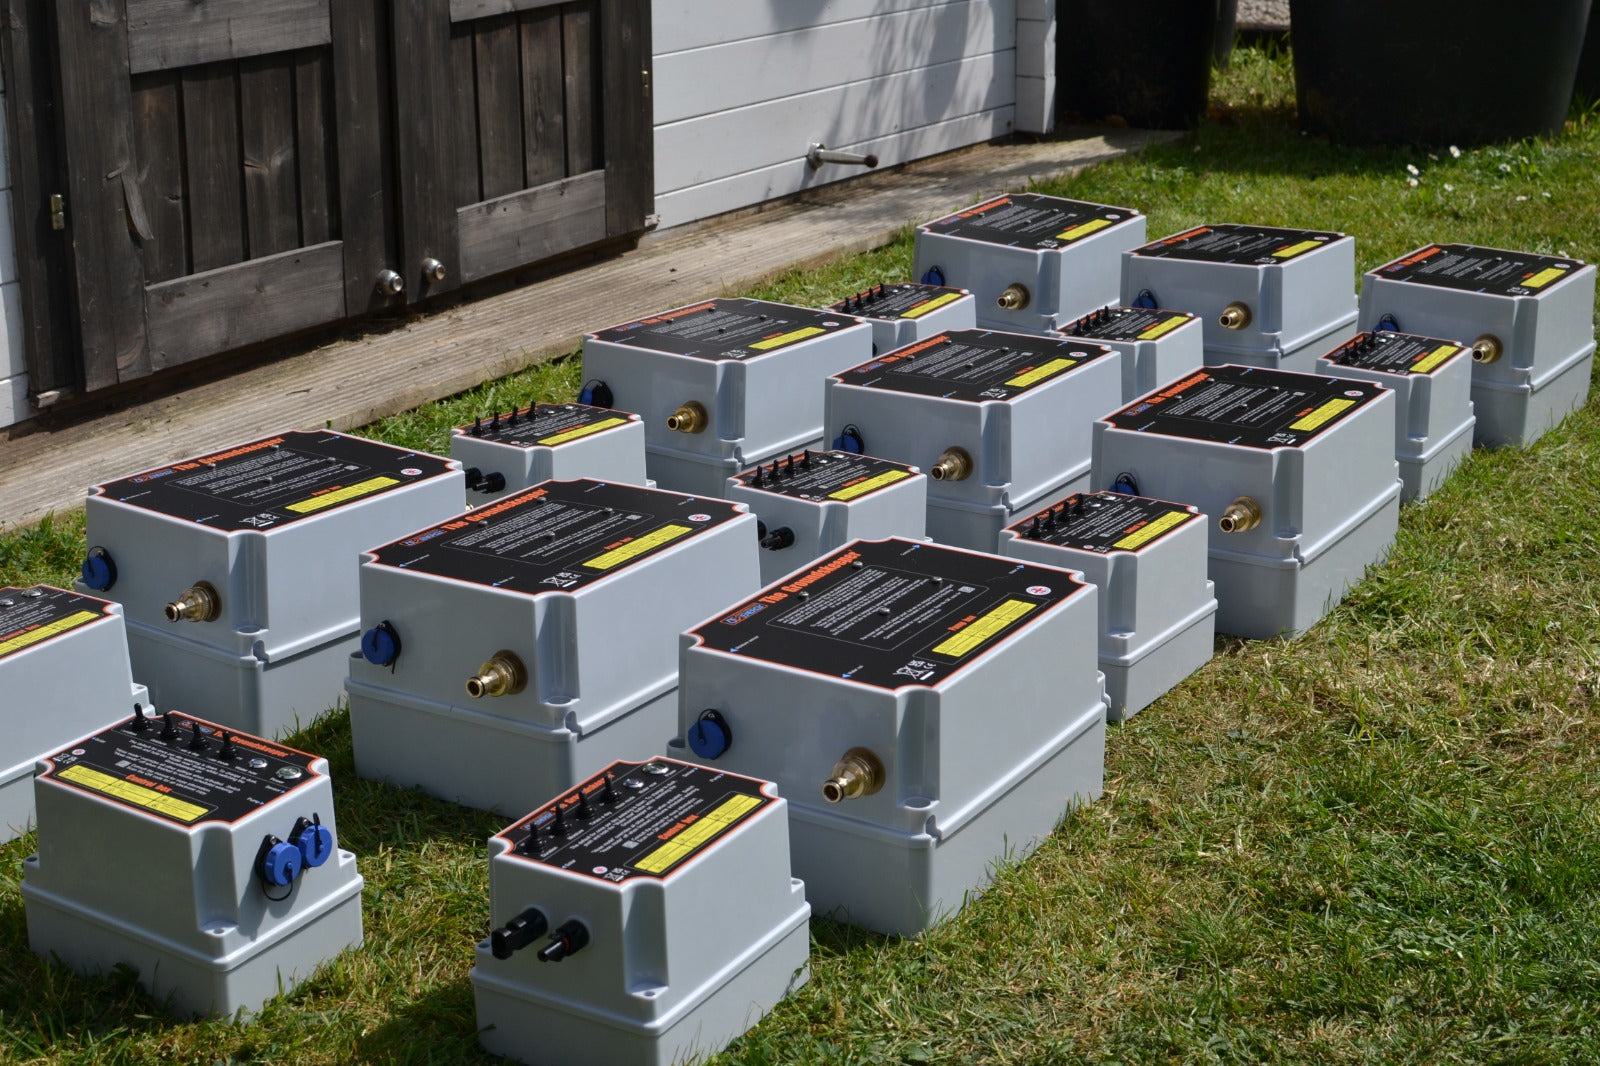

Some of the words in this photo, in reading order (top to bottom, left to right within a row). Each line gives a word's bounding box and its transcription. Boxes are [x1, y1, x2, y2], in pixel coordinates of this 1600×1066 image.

[758, 592, 788, 603] The
[781, 551, 861, 592] Groundskeeper
[126, 774, 157, 787] Control
[155, 784, 172, 793] box
[658, 823, 686, 840] Control
[681, 815, 699, 824] box
